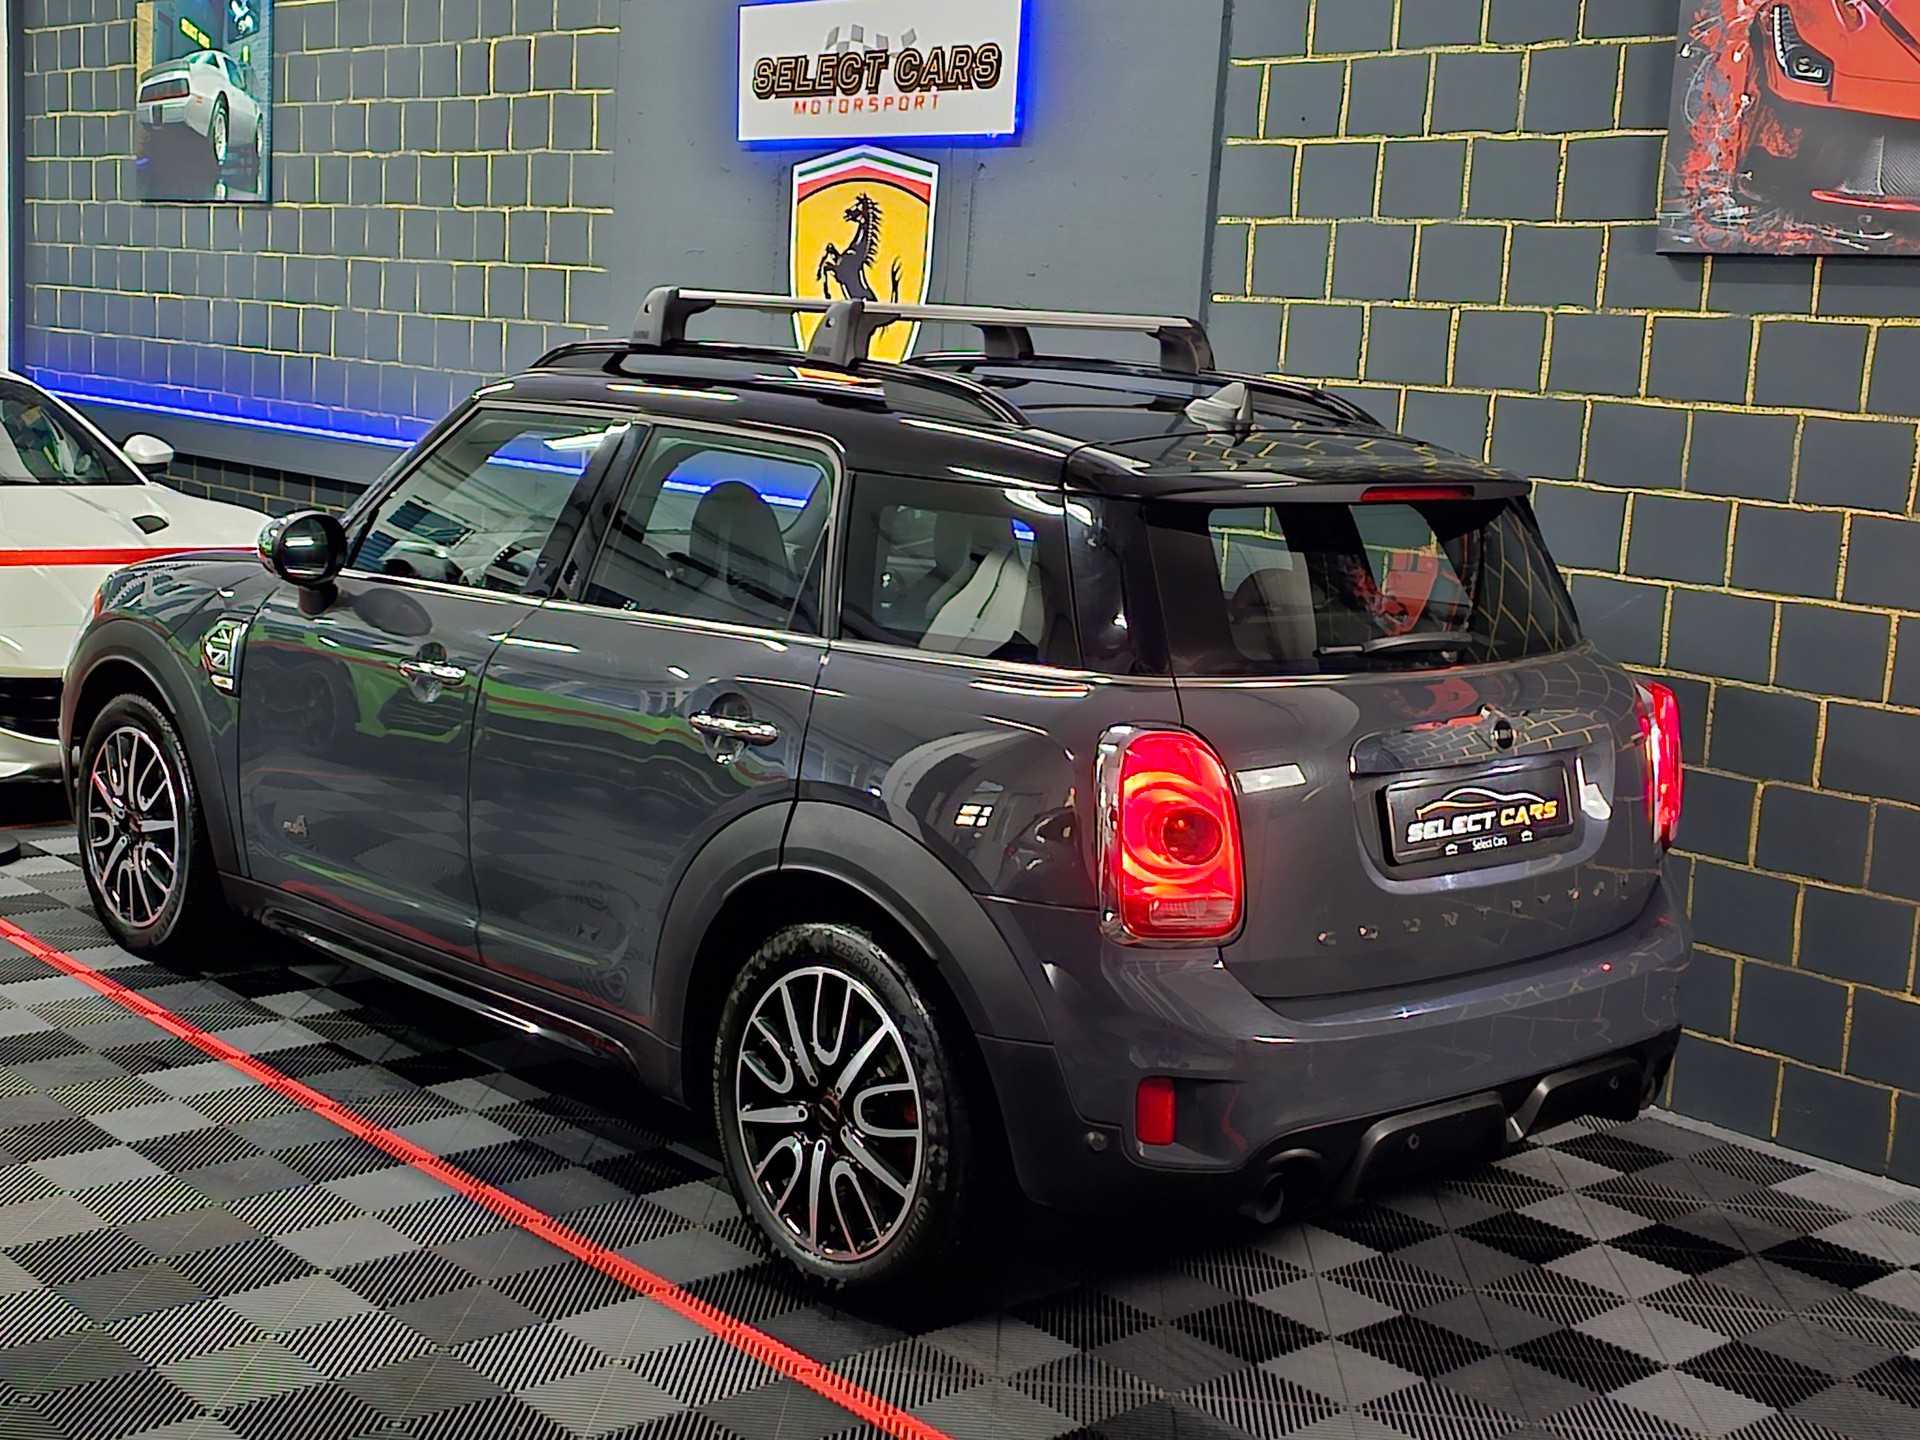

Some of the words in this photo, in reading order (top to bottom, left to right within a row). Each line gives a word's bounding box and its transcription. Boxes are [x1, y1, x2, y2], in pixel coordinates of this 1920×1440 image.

[753, 49, 889, 99] SELECT
[895, 42, 1002, 93] CARS
[793, 94, 940, 115] MOTORSPORT
[1407, 810, 1497, 843] SELECT
[1500, 800, 1558, 827] CARS
[1472, 837, 1493, 851] Select
[1493, 836, 1508, 848] Cars
[835, 939, 870, 970] 225/50
